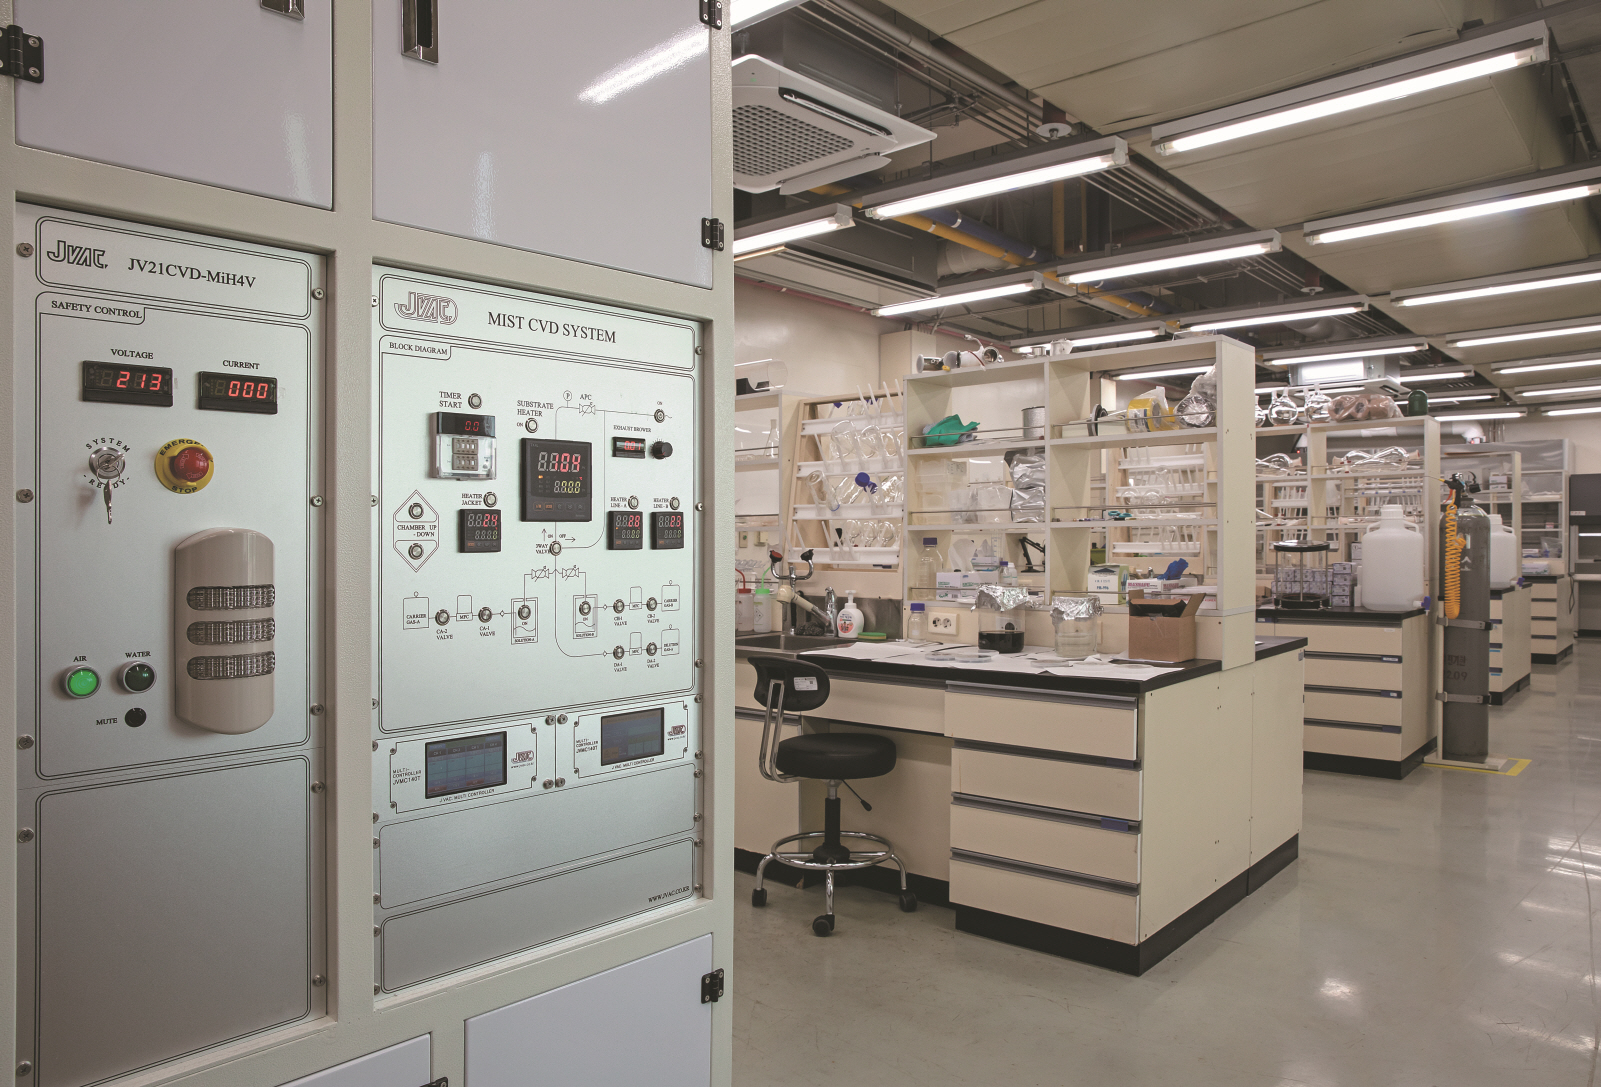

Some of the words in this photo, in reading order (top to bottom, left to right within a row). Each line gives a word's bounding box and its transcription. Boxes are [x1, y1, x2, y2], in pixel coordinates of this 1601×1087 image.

[128, 257, 256, 288] JV21CVD-MiH4V
[51, 300, 92, 313] SAFETY
[94, 306, 143, 319] CONTROL
[487, 311, 525, 329] MIST
[528, 318, 559, 334] CVD
[562, 323, 617, 343] SYSTEM
[389, 342, 413, 351] BLOCK
[414, 345, 448, 355] DIAGRAM
[111, 349, 154, 360] VOLTAGE
[222, 359, 260, 370] CURRENT
[116, 371, 162, 391] 213
[439, 391, 462, 399] TIMER
[580, 393, 592, 401] APC
[439, 400, 462, 409] START
[517, 400, 554, 409] SUBSTRATE
[517, 409, 543, 417] HEATER
[613, 424, 633, 432] EXHAUST
[86, 438, 130, 453] SYSTEM
[88, 478, 126, 489] REDY
[171, 485, 198, 494] STOP
[73, 655, 87, 663] AIR
[125, 651, 151, 659] WATER
[96, 717, 118, 726] MUTE
[393, 770, 422, 779] CONTROLLER
[468, 789, 495, 797] CONTROLLER
